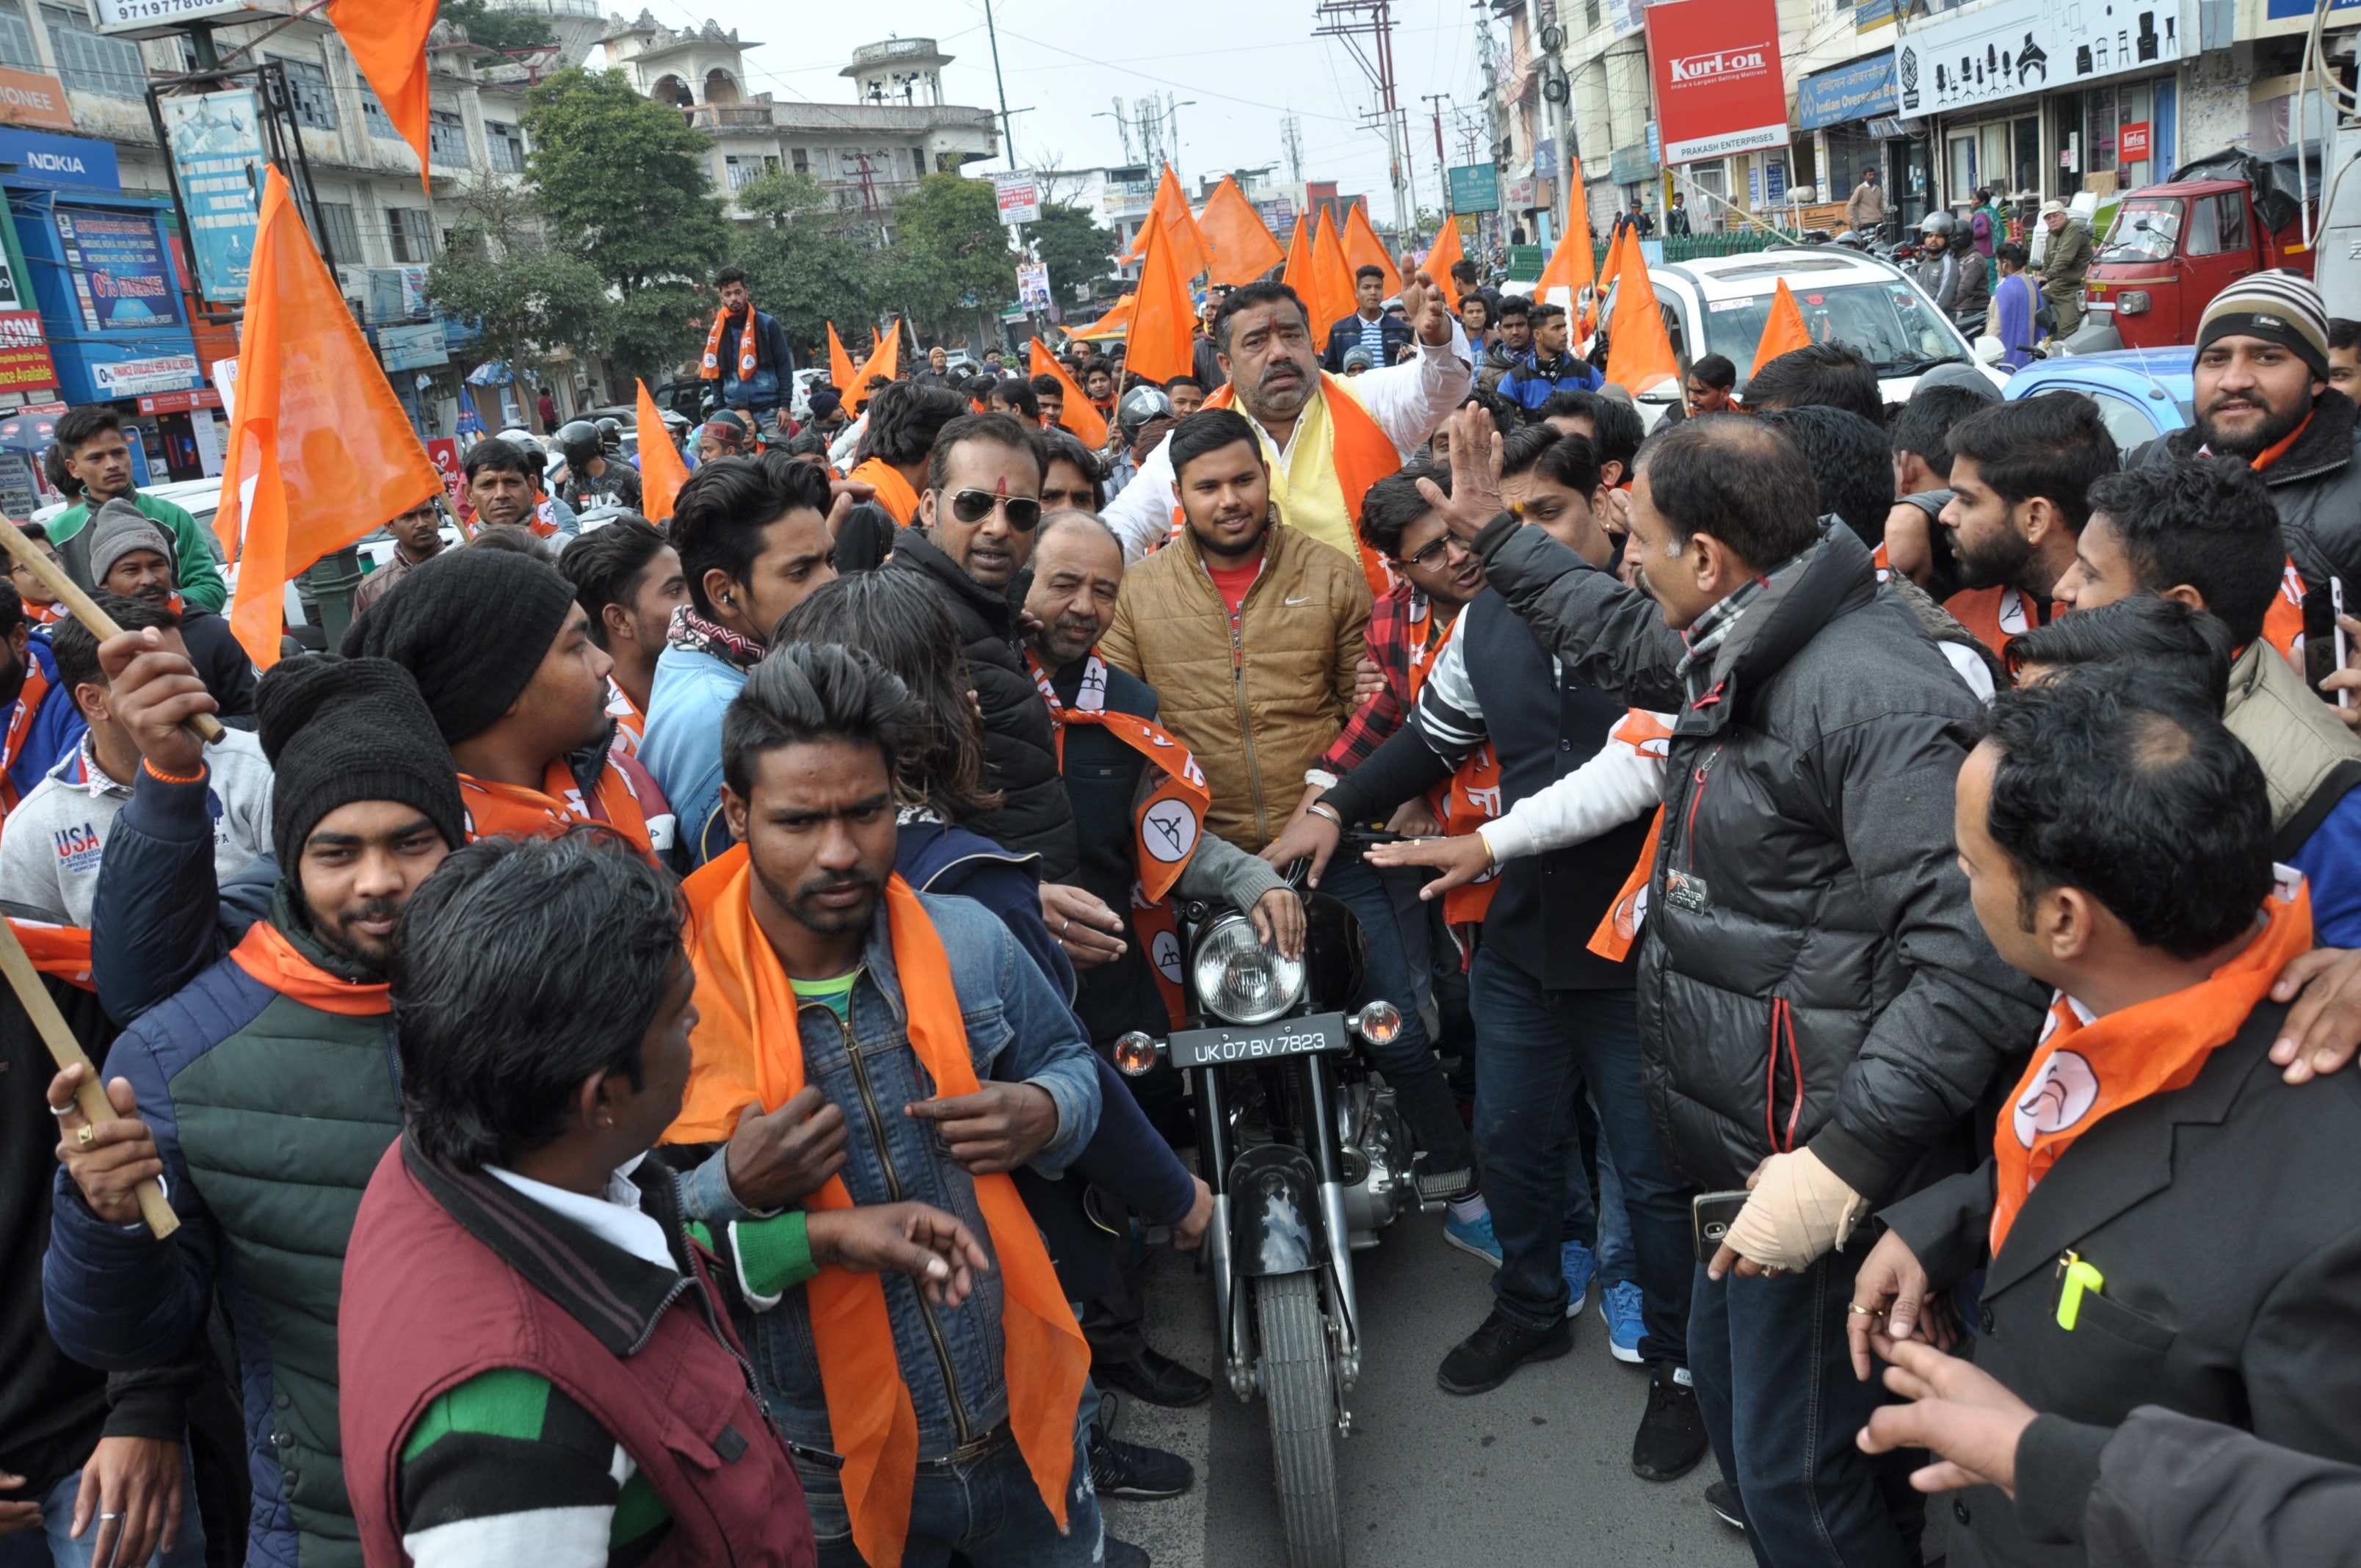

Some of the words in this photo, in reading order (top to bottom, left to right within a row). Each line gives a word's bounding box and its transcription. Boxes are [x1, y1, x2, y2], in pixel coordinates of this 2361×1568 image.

[1669, 52, 1766, 82] Kurl-on
[1816, 98, 1840, 115] Indian
[1841, 89, 1881, 108] Overseas
[1681, 142, 1719, 157] PRAKASH
[1720, 132, 1774, 150] ENTERPRISES
[26, 151, 86, 174] NOKIA
[55, 822, 100, 857] USA
[1678, 884, 1702, 901] Lowe
[1195, 1044, 1220, 1061] UK
[1223, 1041, 1247, 1059] 07
[1250, 1038, 1274, 1056] BV
[1277, 1033, 1325, 1053] 7823
